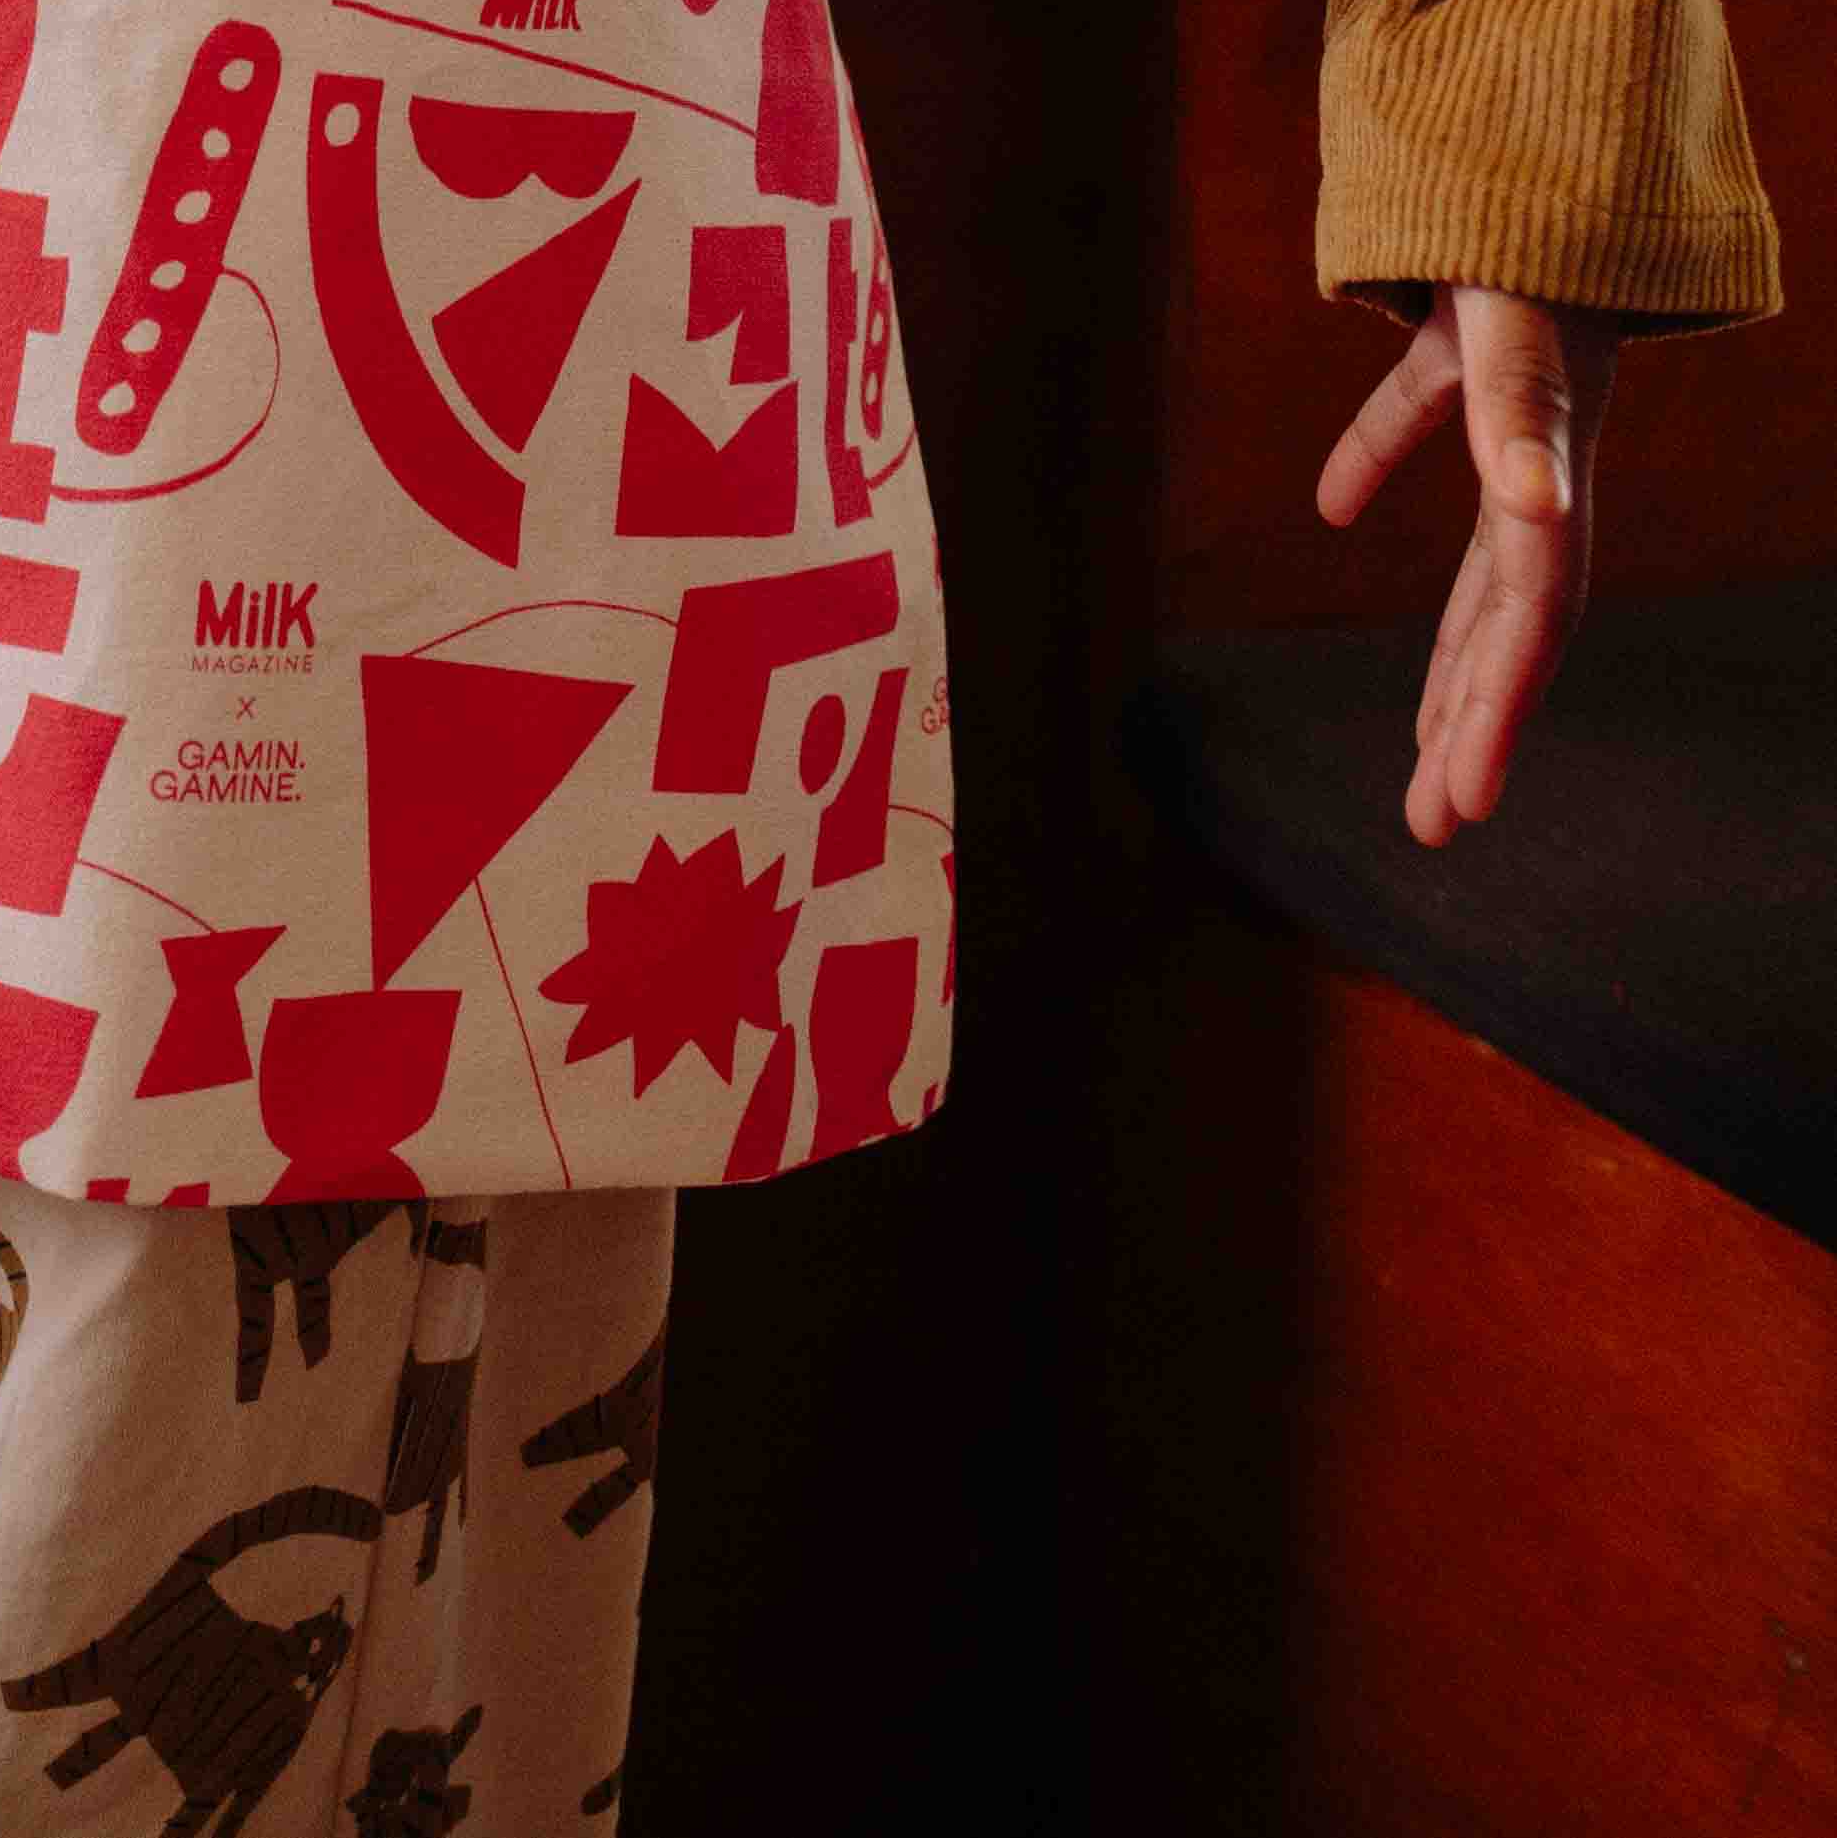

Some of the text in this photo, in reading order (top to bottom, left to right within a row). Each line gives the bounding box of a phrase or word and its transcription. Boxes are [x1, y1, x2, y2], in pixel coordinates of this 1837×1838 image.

[191, 654, 315, 674] MAGAZINE
[177, 740, 307, 771] GAMIN.
[150, 771, 302, 804] GAMINE.
